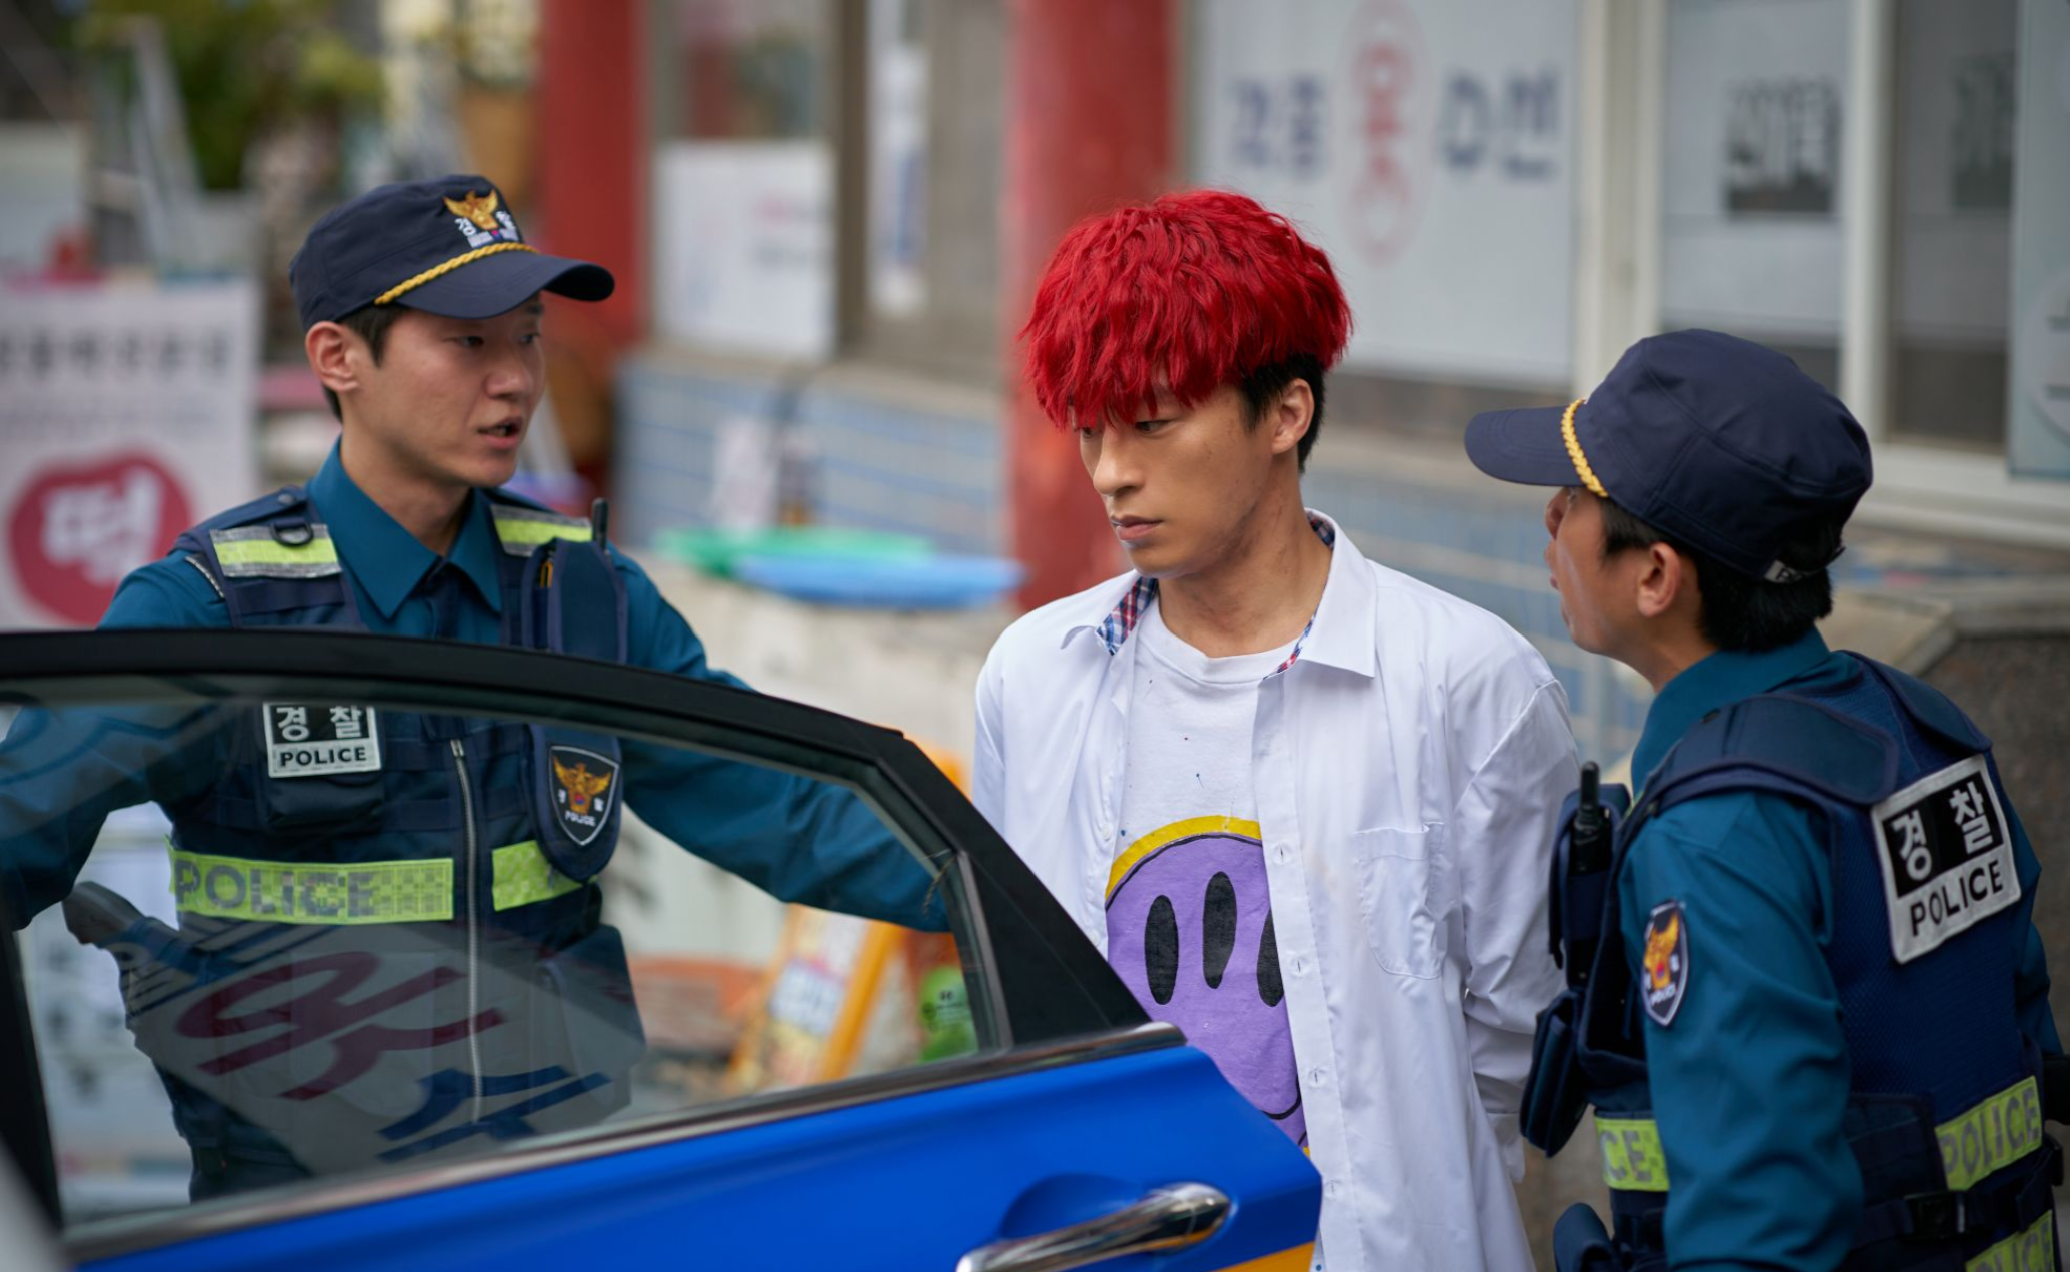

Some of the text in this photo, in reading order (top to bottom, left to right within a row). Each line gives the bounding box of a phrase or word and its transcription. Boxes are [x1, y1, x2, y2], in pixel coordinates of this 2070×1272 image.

[279, 746, 367, 768] POLICE
[175, 858, 376, 917] POLICE
[1909, 860, 2004, 938] POLICE
